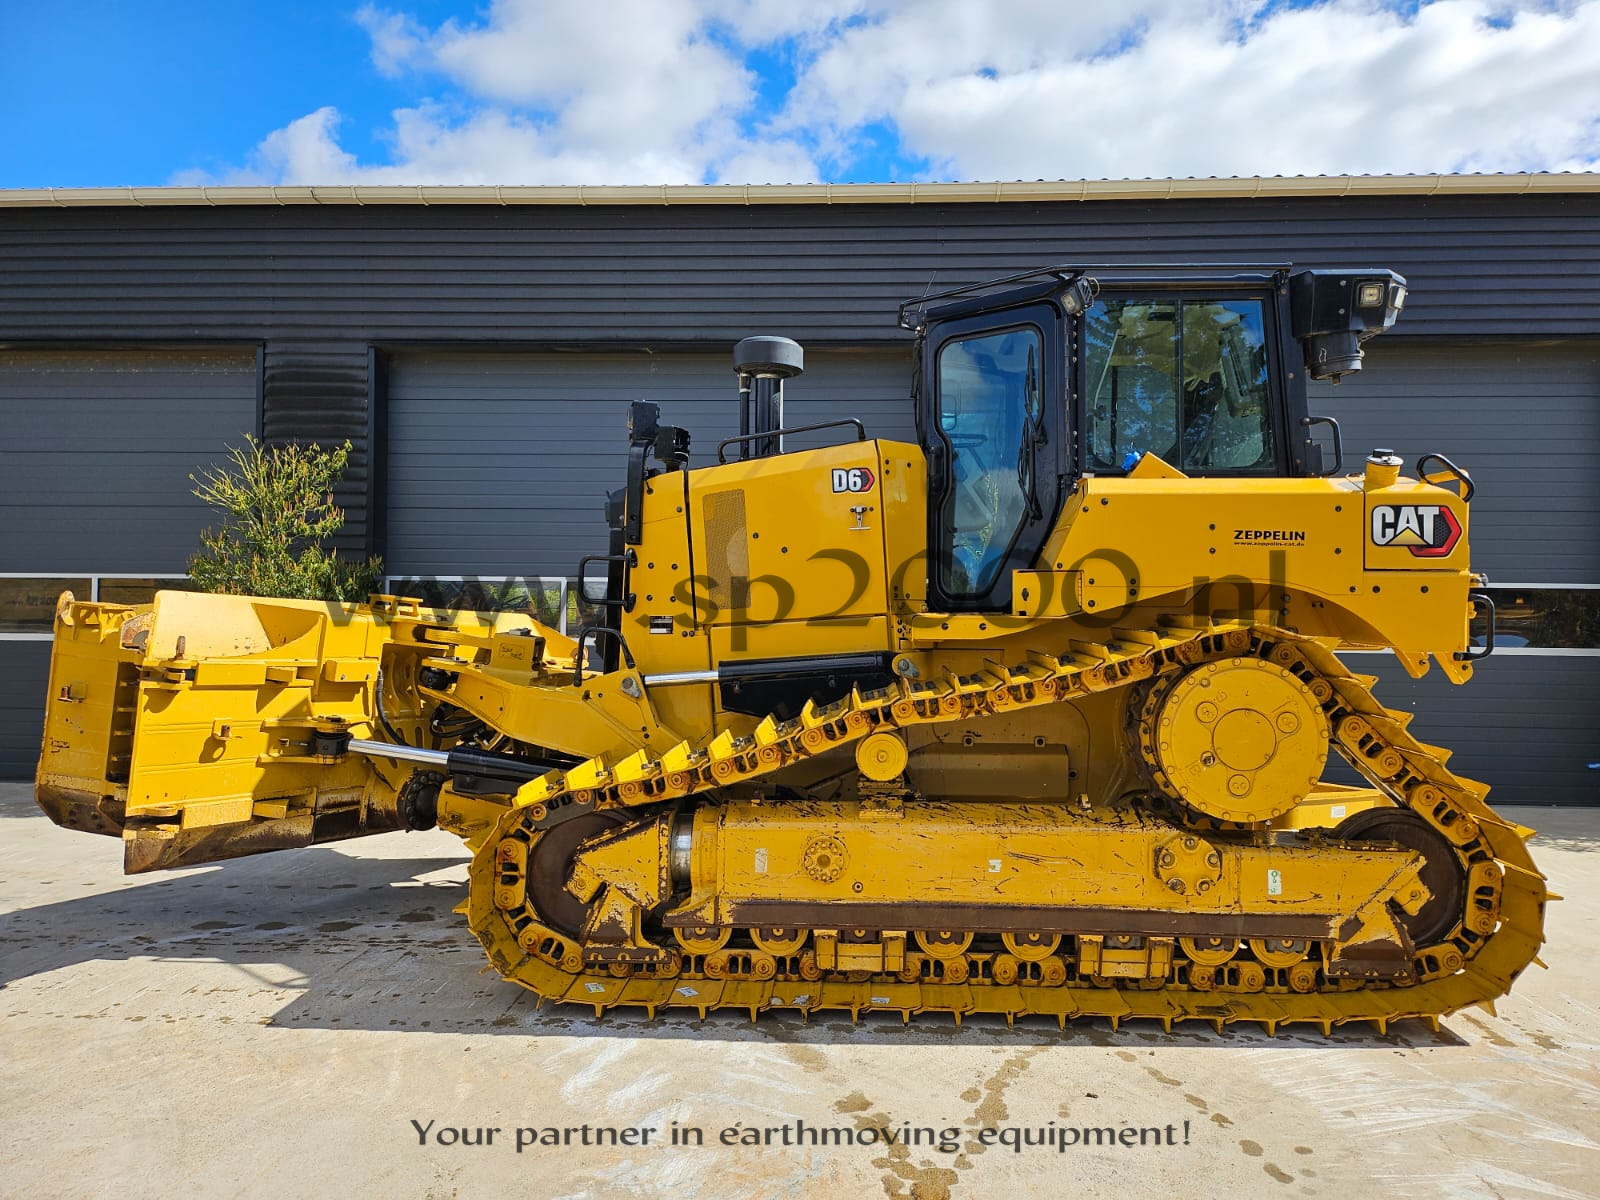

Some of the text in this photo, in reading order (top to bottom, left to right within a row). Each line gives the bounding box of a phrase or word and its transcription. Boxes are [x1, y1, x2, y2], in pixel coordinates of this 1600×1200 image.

[832, 469, 862, 492] D6
[1234, 530, 1305, 541] ZEPPELIN
[1372, 505, 1440, 546] CAT
